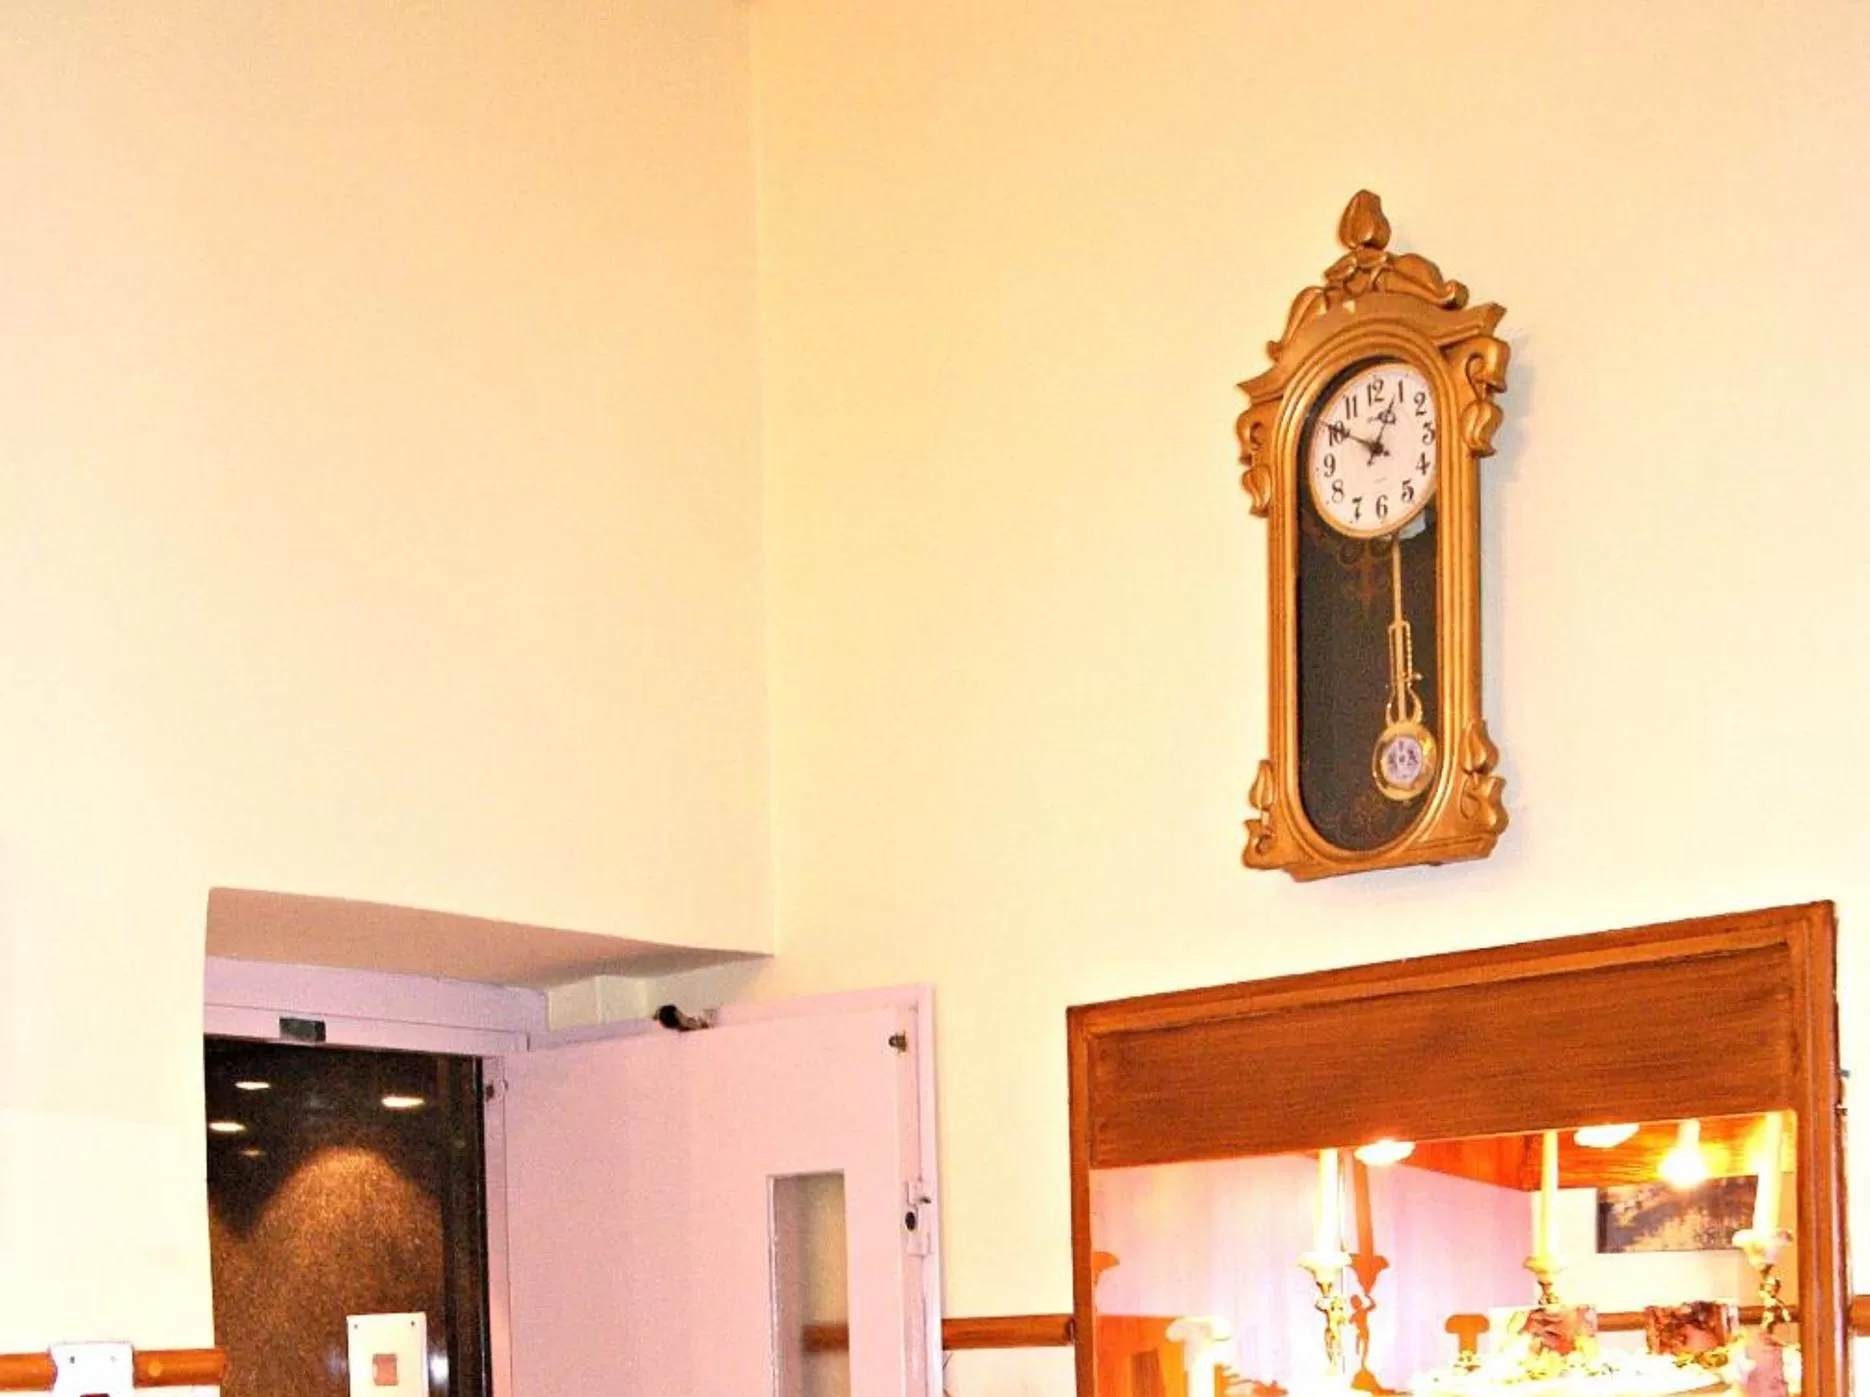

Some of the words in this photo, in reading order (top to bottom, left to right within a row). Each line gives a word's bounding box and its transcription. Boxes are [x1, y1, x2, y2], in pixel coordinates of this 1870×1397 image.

[1366, 379, 1384, 406] 12
[1398, 380, 1403, 403] 1
[1346, 395, 1357, 420] 11
[1414, 392, 1427, 416] 2
[1422, 422, 1435, 445] 3
[1323, 453, 1336, 478] 9
[1415, 452, 1430, 475] 4
[1331, 479, 1345, 503] 8
[1400, 479, 1415, 502] 5
[1352, 496, 1362, 520] 7
[1376, 494, 1388, 519] 6
